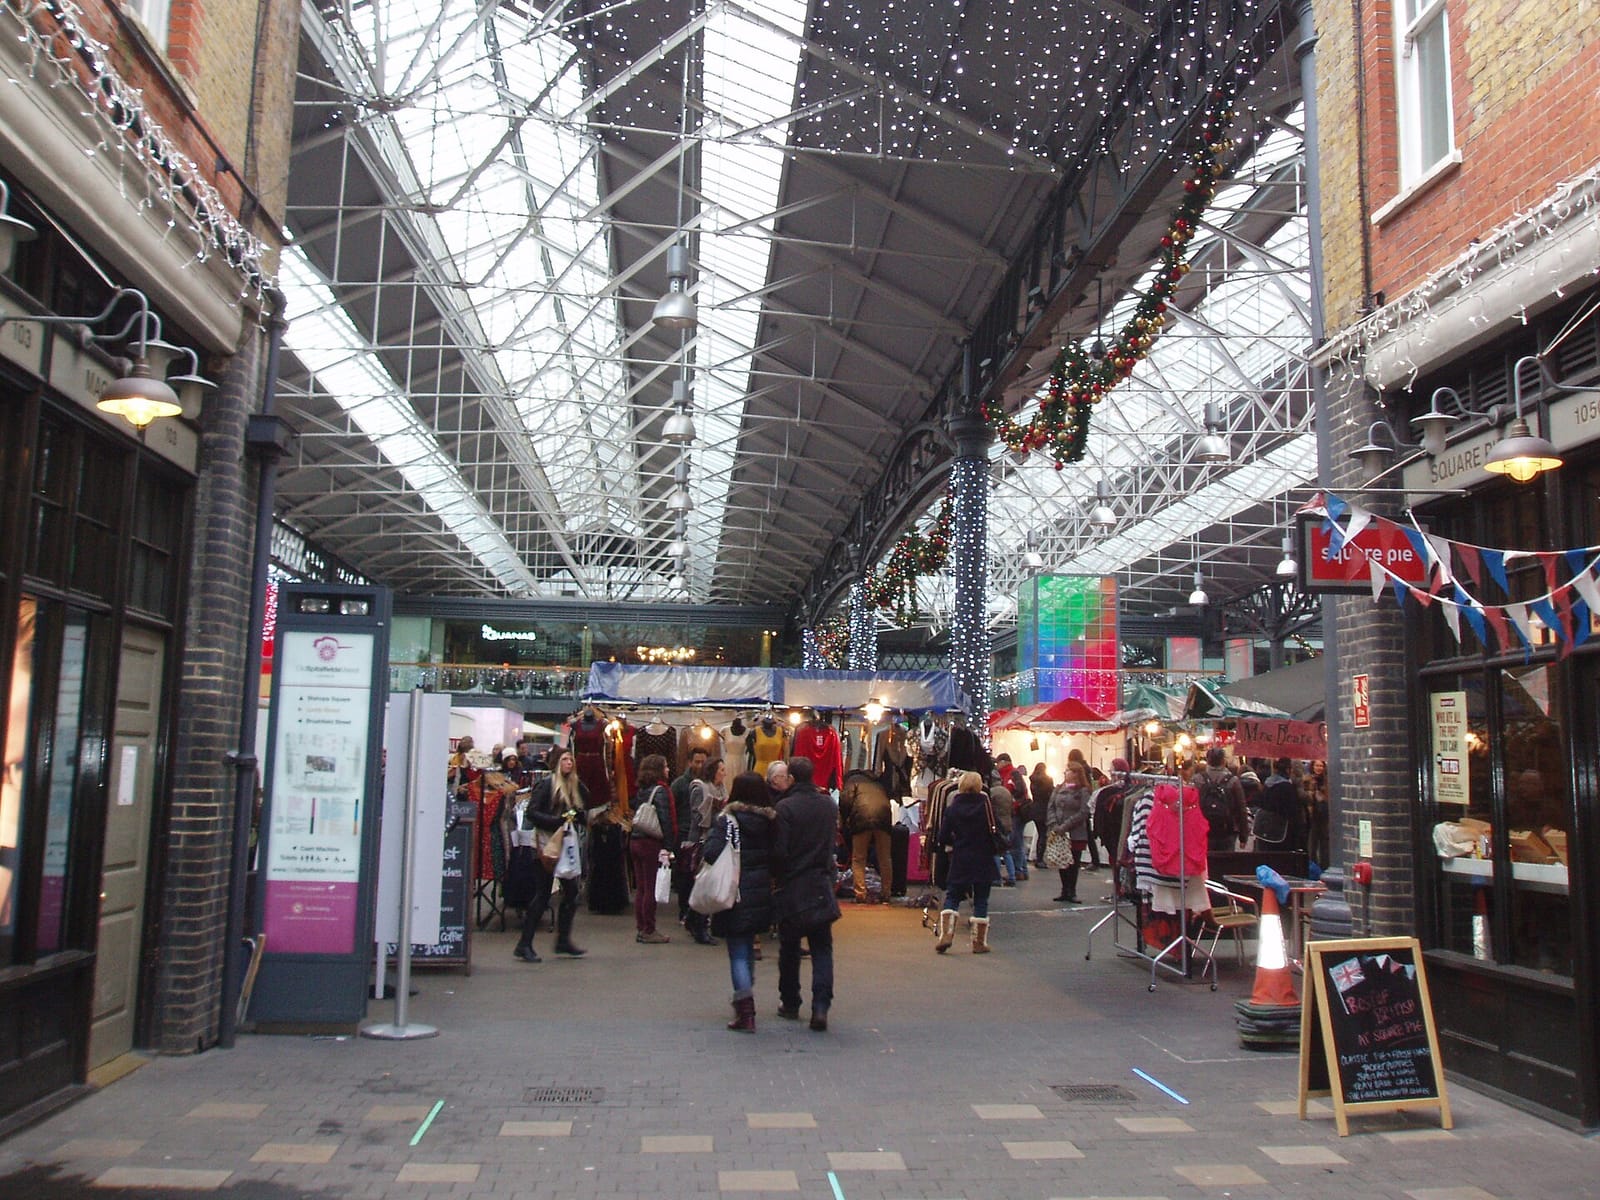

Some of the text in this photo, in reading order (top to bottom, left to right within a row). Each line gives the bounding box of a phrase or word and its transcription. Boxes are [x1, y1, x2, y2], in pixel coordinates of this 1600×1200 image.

[13, 322, 32, 348] 103
[1431, 446, 1481, 484] SQUARE
[1321, 548, 1413, 566] squre pie
[451, 804, 472, 815] Bar
